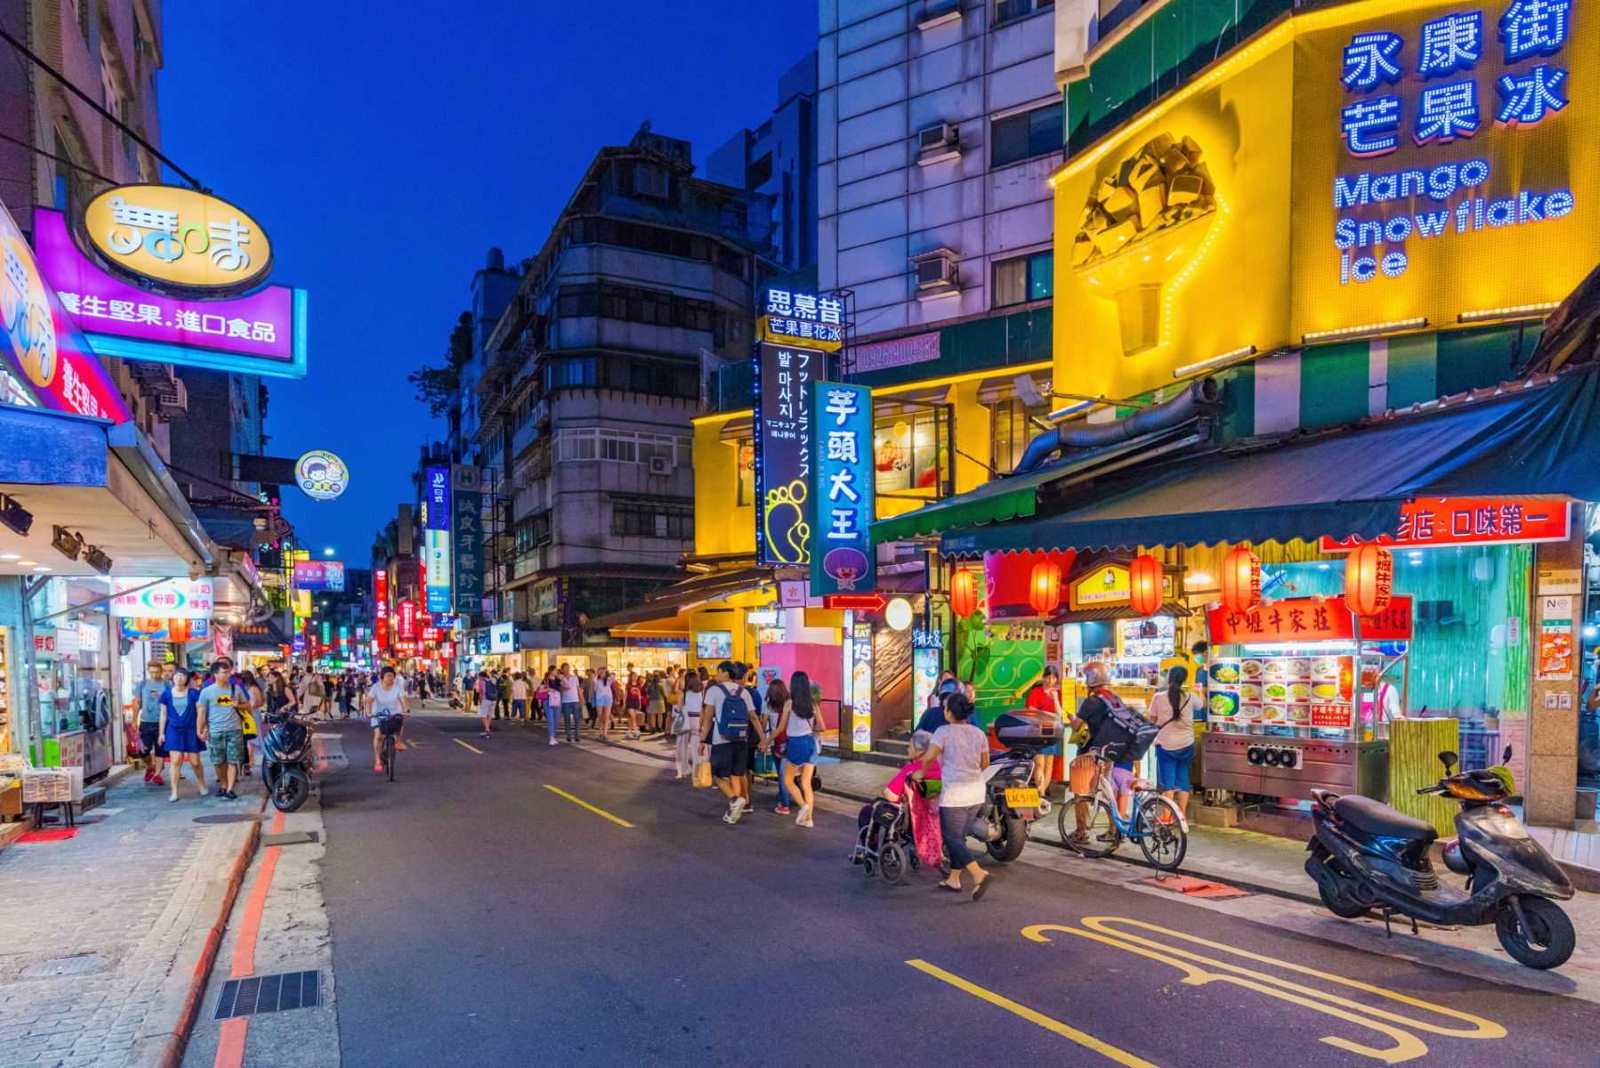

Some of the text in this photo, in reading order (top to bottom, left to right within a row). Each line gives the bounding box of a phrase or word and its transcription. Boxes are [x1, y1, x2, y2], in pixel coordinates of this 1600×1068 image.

[1342, 0, 1570, 87] 永康街
[1343, 66, 1566, 152] 芒果冰
[1334, 160, 1489, 208] Mango
[767, 289, 841, 324] 思慕昔
[825, 389, 858, 540] 芋頭大王
[1451, 504, 1549, 537] 口味第一
